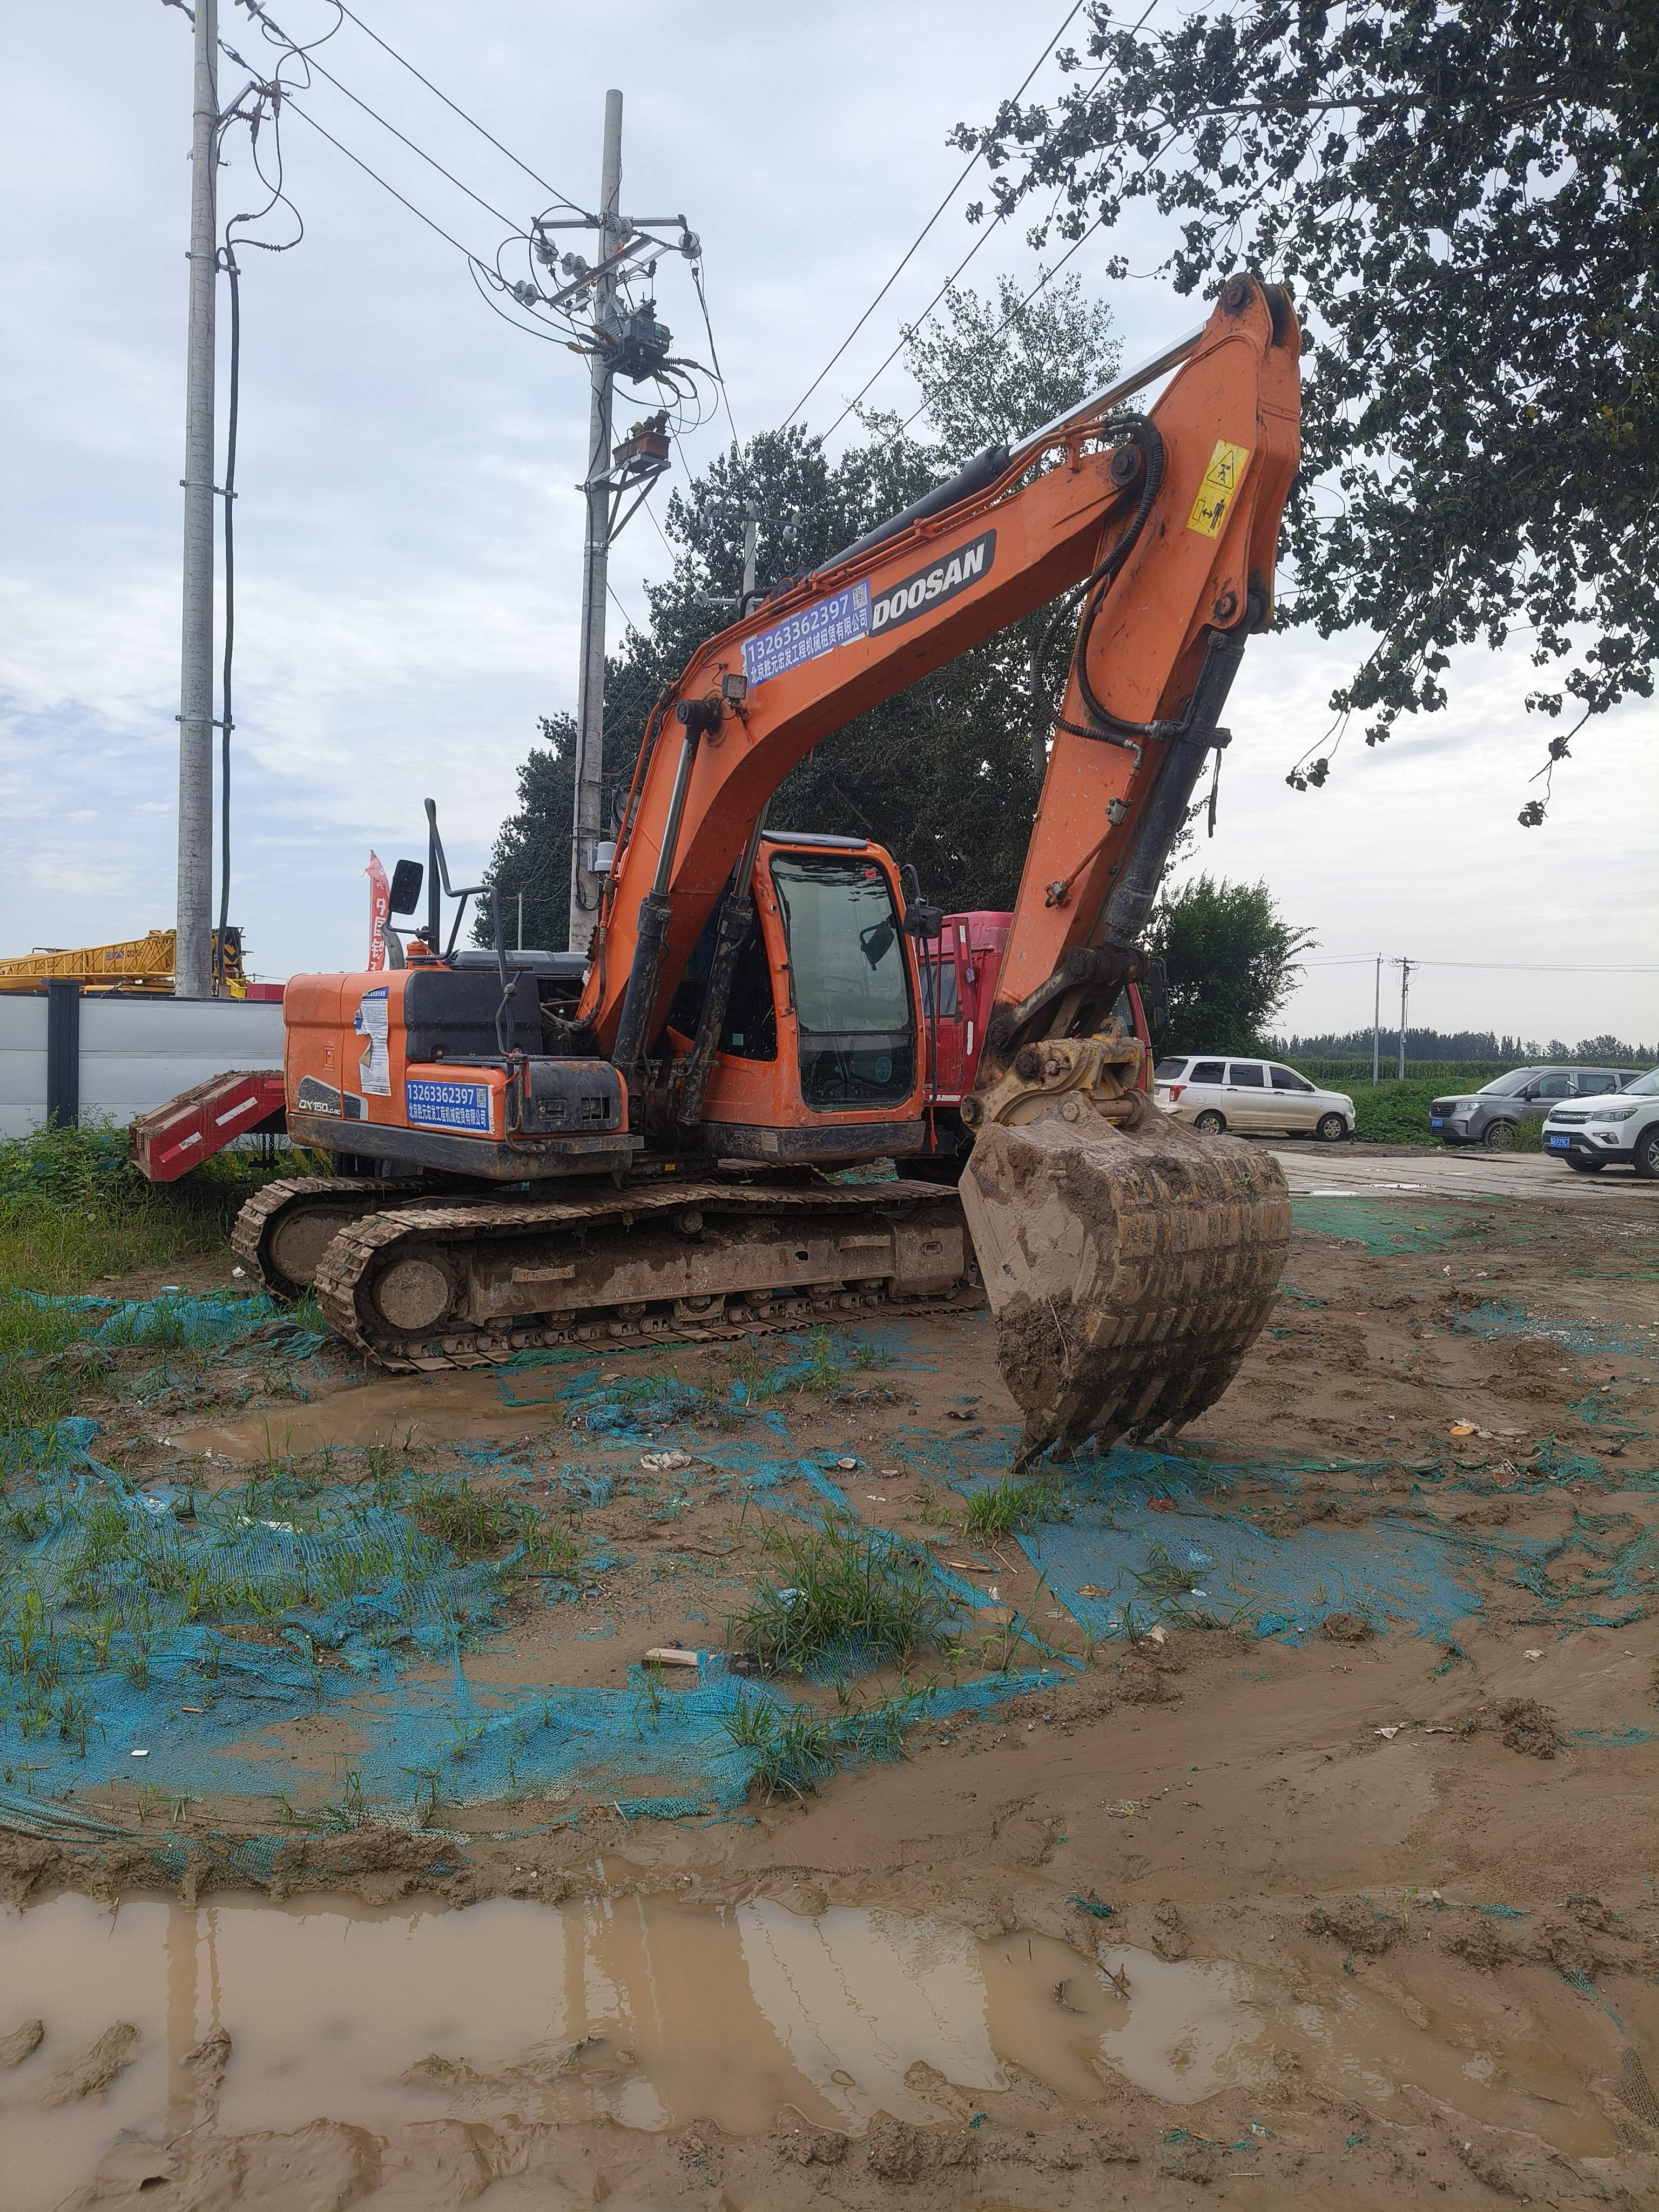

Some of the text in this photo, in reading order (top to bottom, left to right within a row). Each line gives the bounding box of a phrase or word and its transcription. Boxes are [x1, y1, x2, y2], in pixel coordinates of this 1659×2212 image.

[873, 543, 985, 628] DOOSAN
[748, 595, 848, 663] 13263362397
[751, 608, 867, 684] 北京胜元宏发工程机械租赁有限公司
[407, 1084, 474, 1105] 13263362397
[409, 1103, 486, 1127] 北京胜元宏发工程机械租赁有限公司
